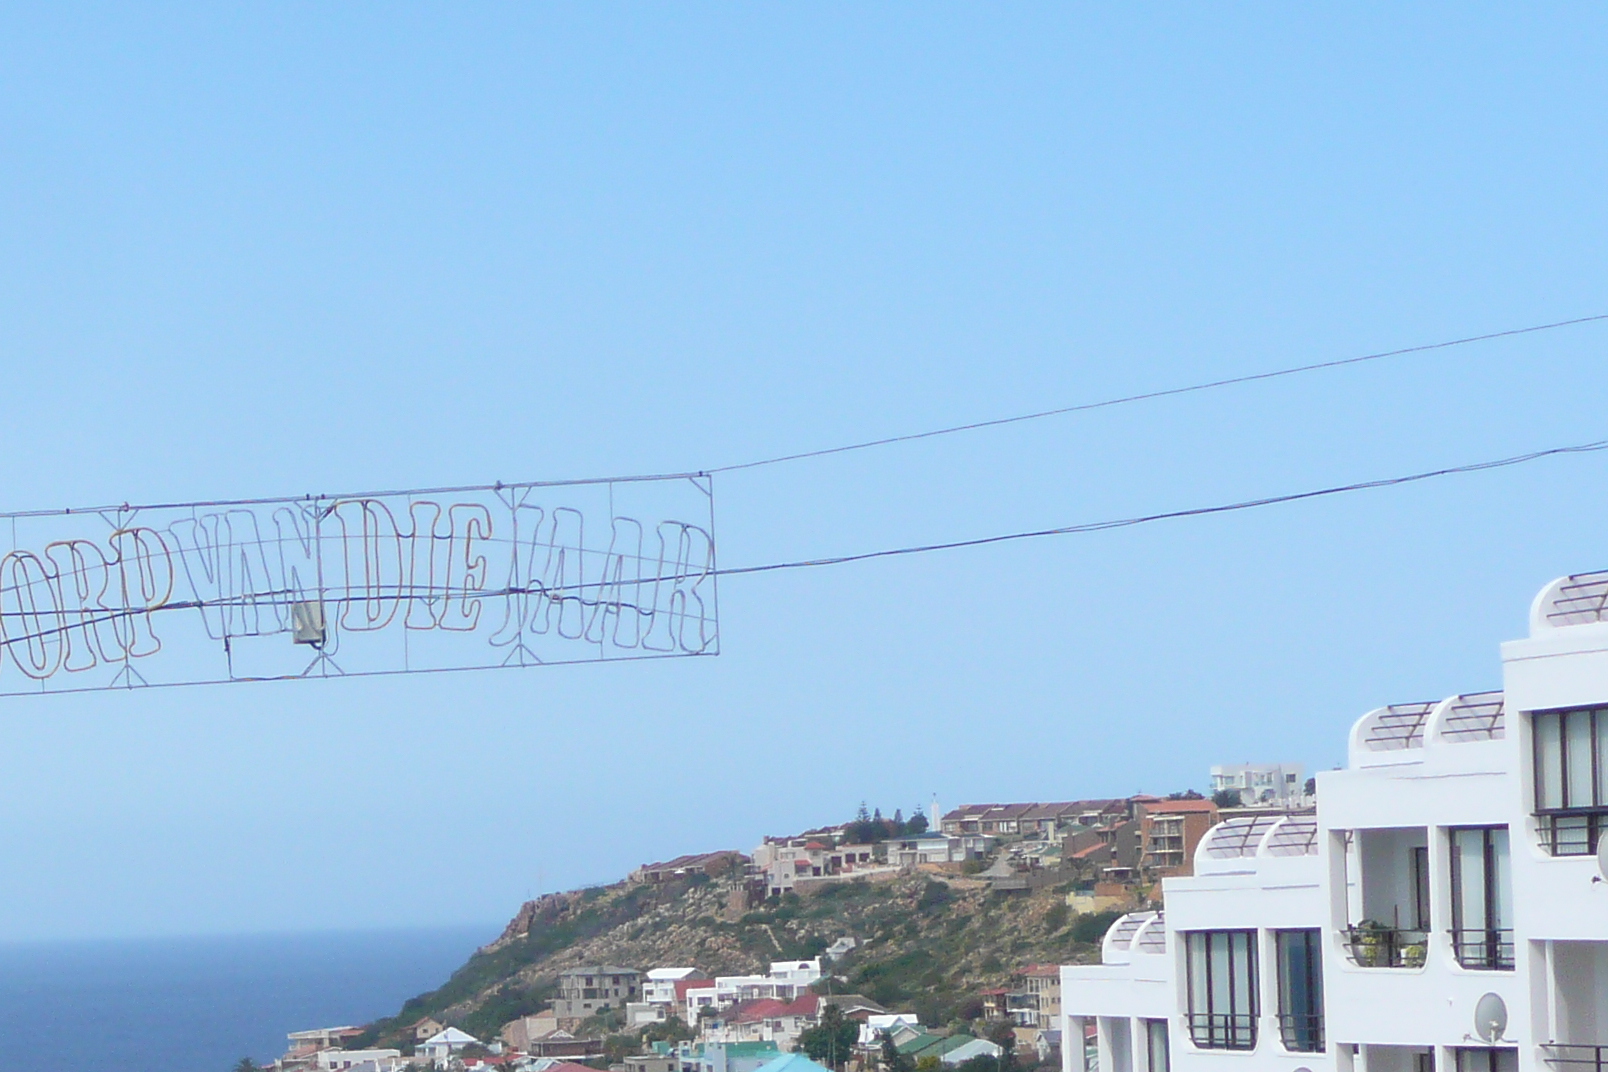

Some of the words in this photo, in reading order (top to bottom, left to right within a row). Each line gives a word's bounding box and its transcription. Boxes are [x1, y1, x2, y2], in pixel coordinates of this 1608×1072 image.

[169, 505, 330, 642] VAN
[334, 500, 493, 631] DIE
[489, 504, 714, 655] JAAR
